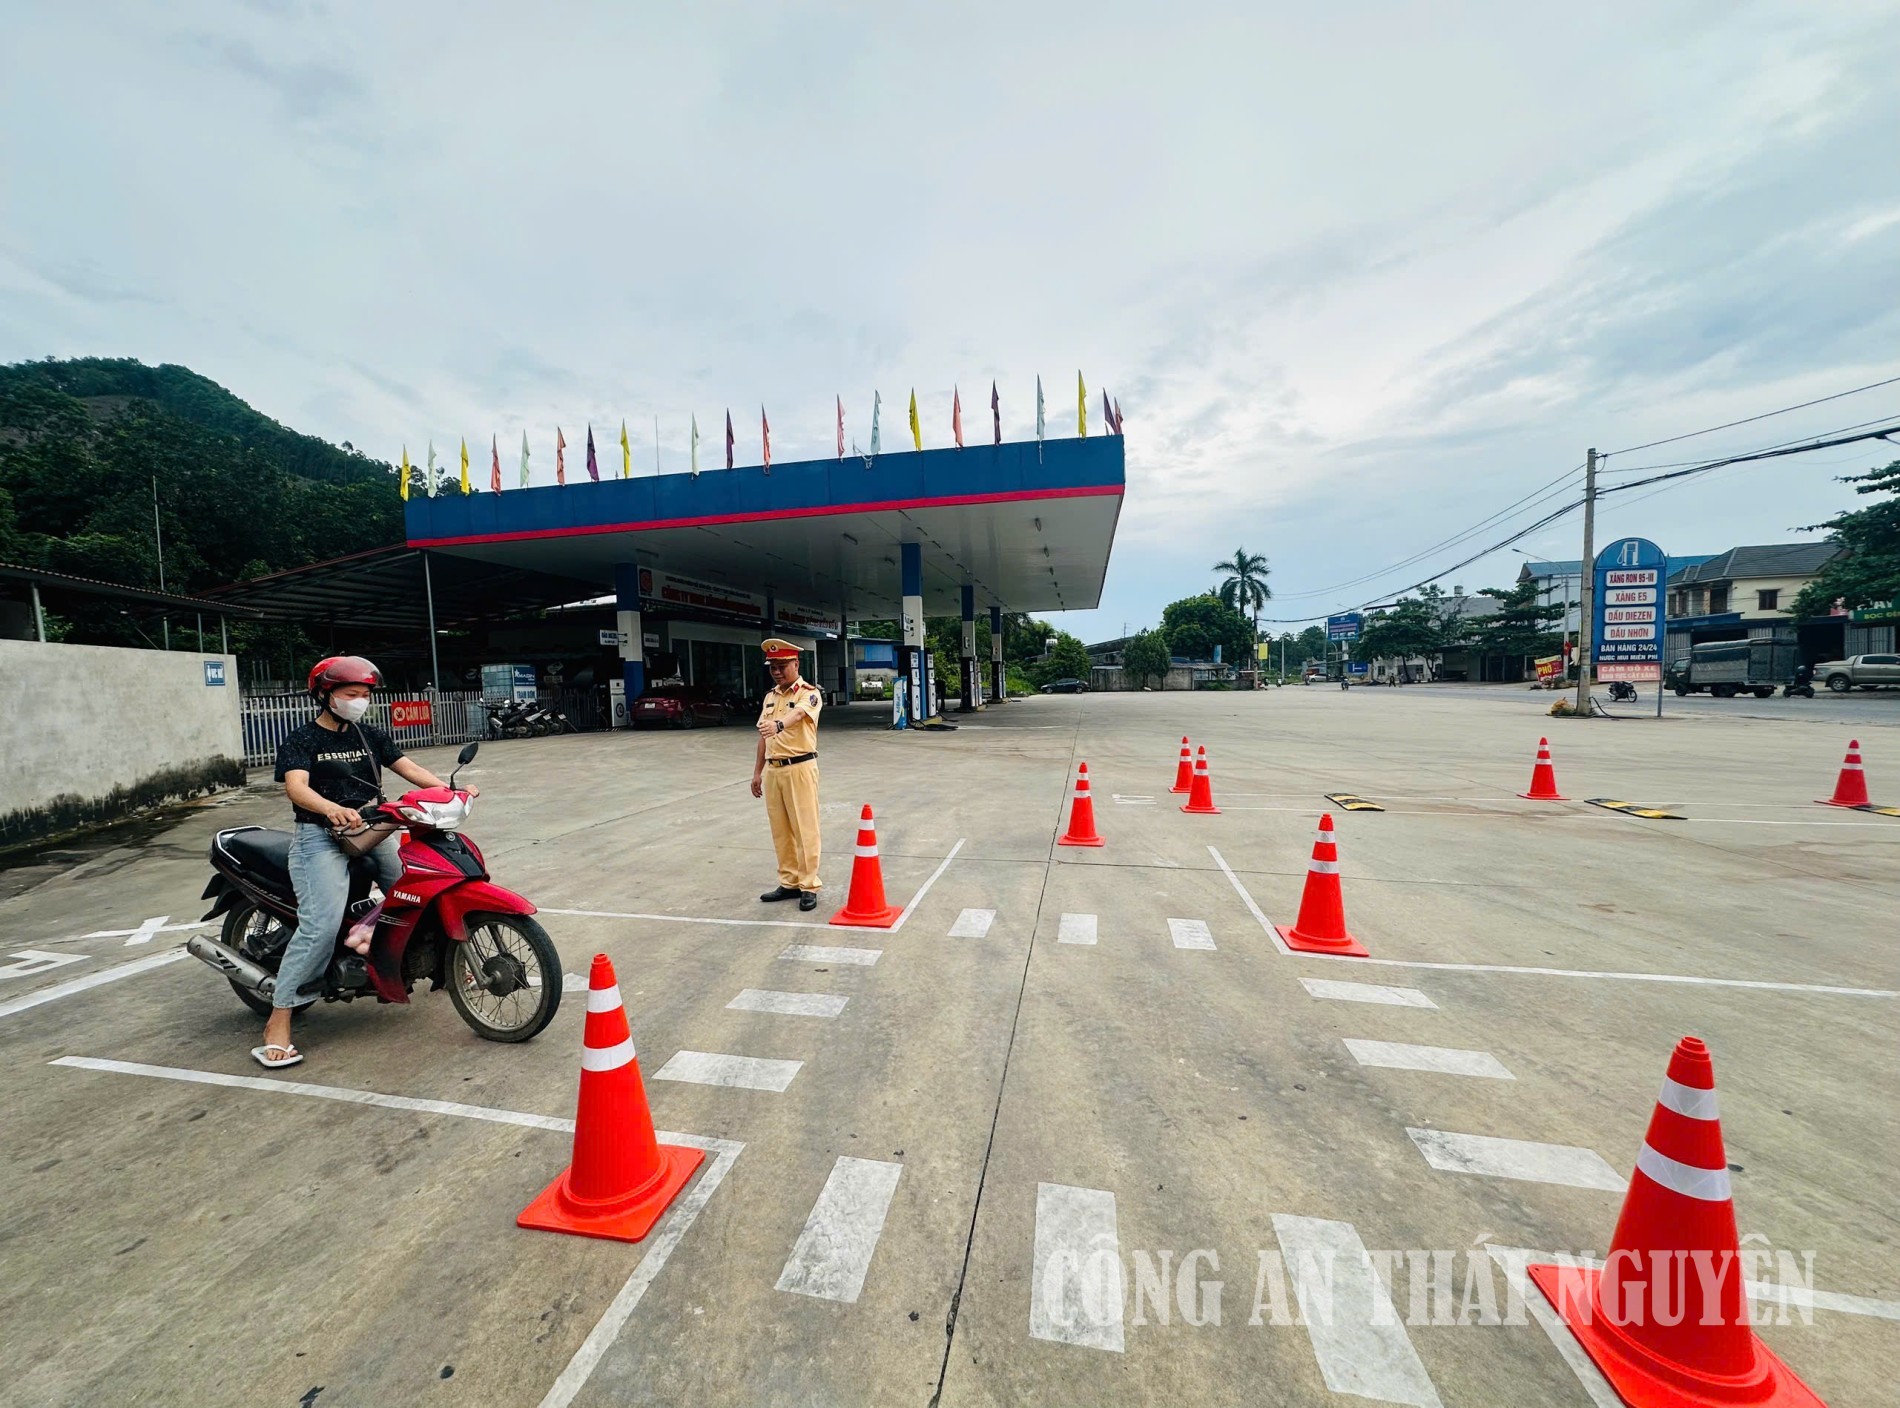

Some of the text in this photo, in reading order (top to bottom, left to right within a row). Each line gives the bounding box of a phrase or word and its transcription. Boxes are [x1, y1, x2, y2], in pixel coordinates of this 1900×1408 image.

[1610, 573, 1624, 583] XĂNG
[1626, 573, 1637, 583] RON
[1615, 591, 1647, 602] XĂNG E5
[1625, 610, 1652, 621] DIEZEN
[1617, 642, 1636, 652] HÀNG
[1638, 643, 1657, 652] 24/24
[405, 702, 419, 721] CẤM
[317, 749, 373, 762] ESSENTIAL
[393, 889, 421, 904] YAMAHA
